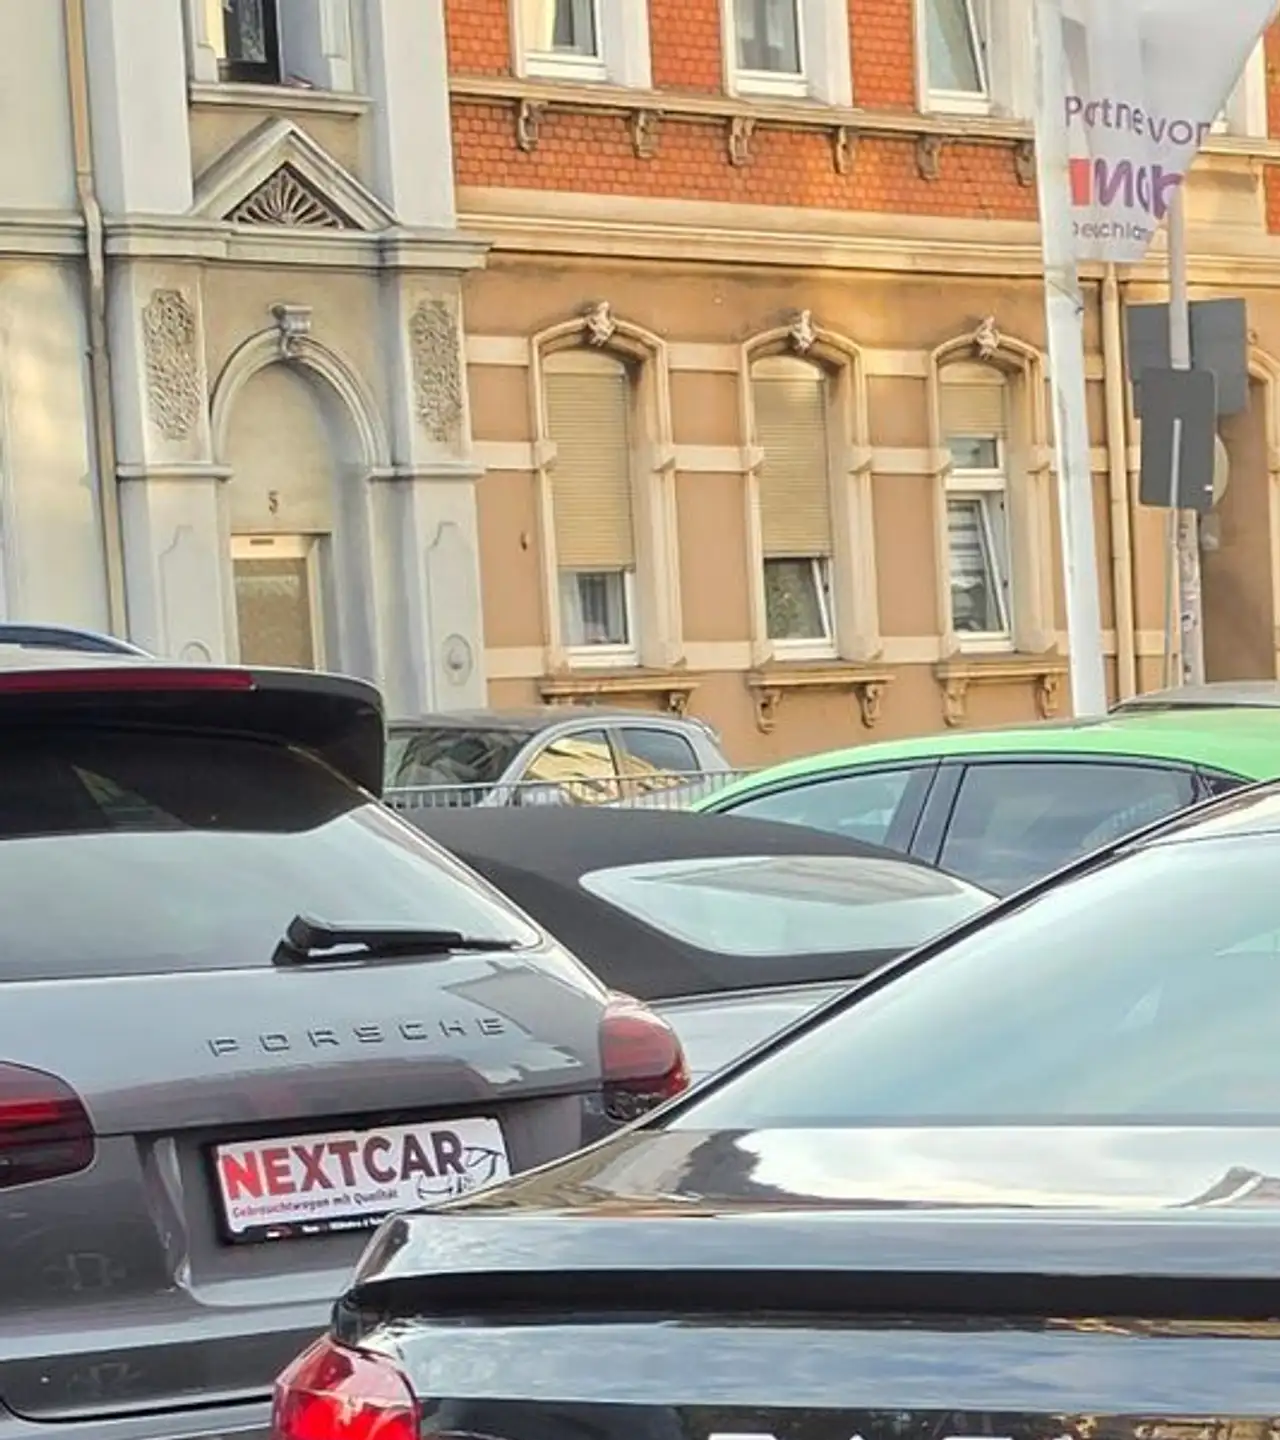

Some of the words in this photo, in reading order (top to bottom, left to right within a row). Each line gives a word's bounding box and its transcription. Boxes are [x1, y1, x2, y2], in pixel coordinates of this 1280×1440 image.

[208, 1017, 505, 1057] PORSCHE
[220, 1130, 467, 1200] NEXTCAR
[232, 1196, 330, 1218] Gebrauchtwagen
